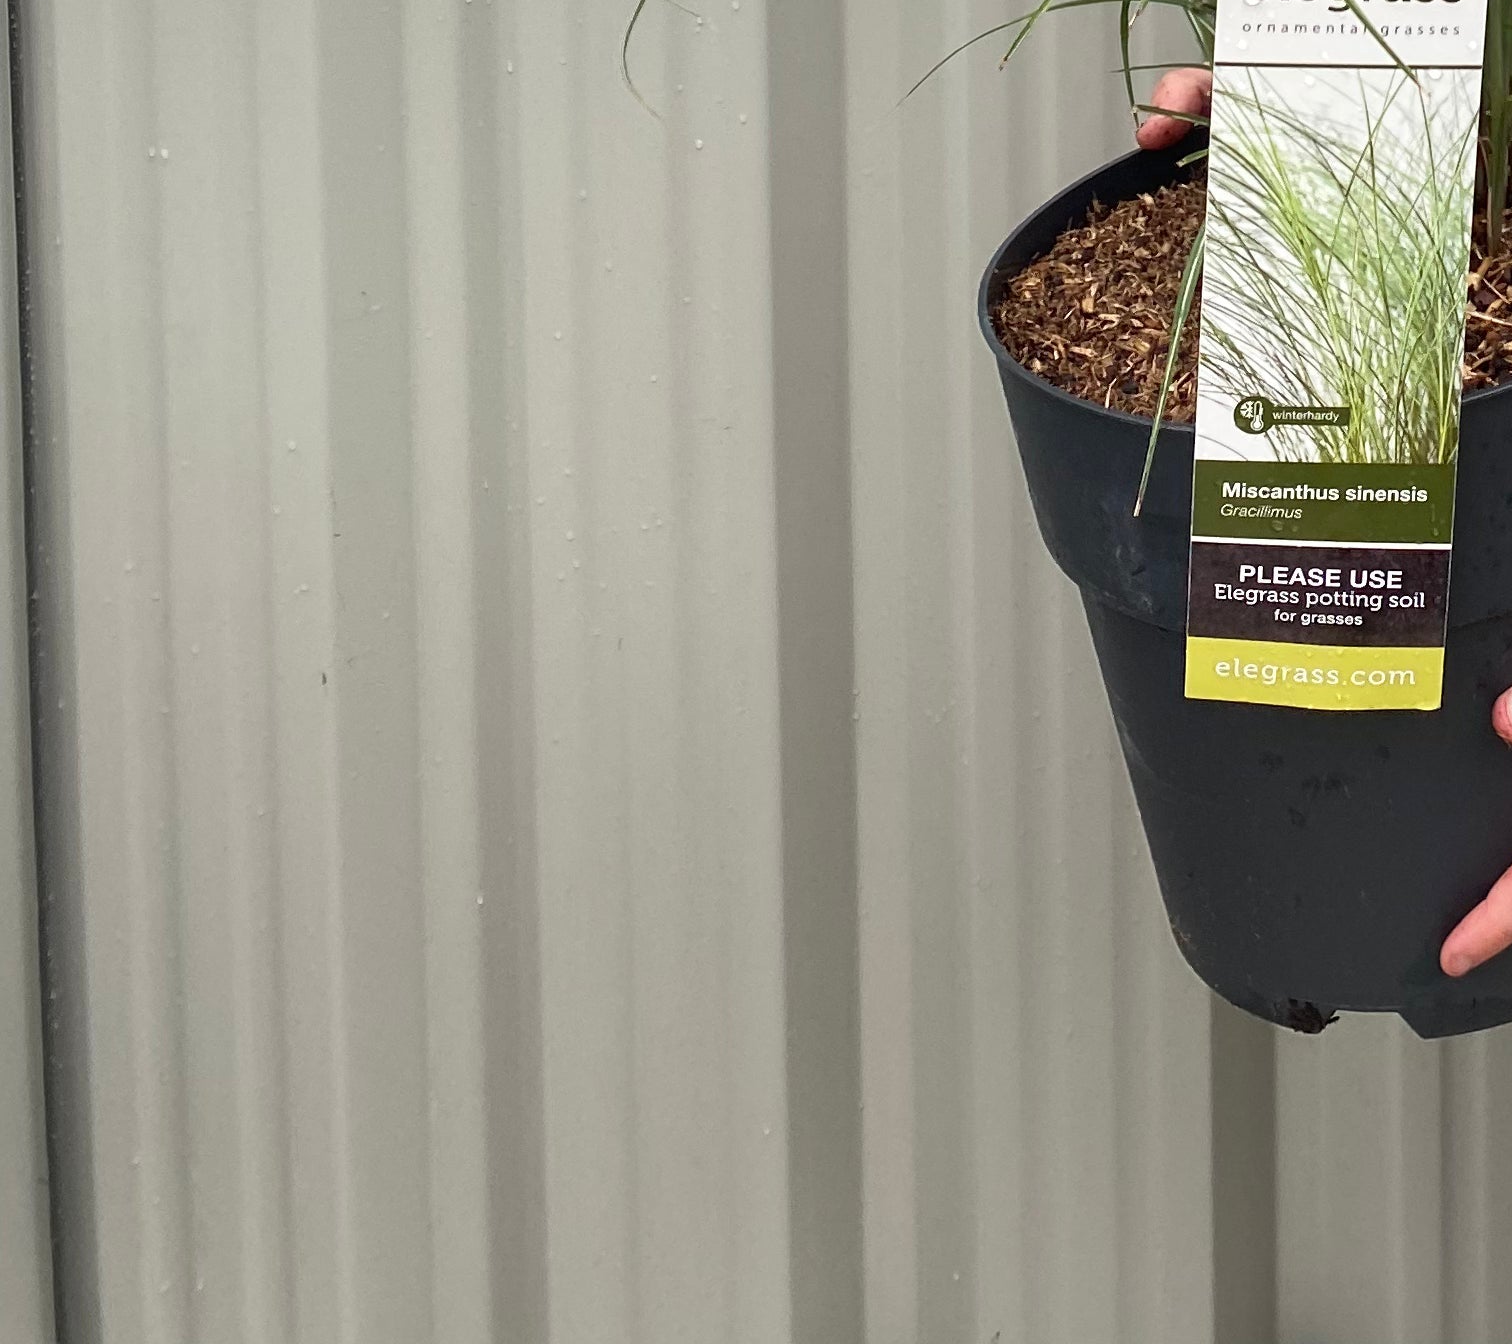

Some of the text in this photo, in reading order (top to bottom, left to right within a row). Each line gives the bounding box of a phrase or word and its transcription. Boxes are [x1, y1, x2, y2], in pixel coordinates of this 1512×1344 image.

[1380, 24, 1460, 37] grasses
[1272, 409, 1340, 423] winterhardy
[1222, 482, 1428, 502] Miscanthus sinensis
[1220, 503, 1303, 519] Gracillimus
[1239, 564, 1403, 589] PLEASE USE
[1214, 583, 1425, 612] Elegrass potting soil
[1274, 608, 1363, 626] for grasses
[1215, 657, 1416, 686] elegrass.com
